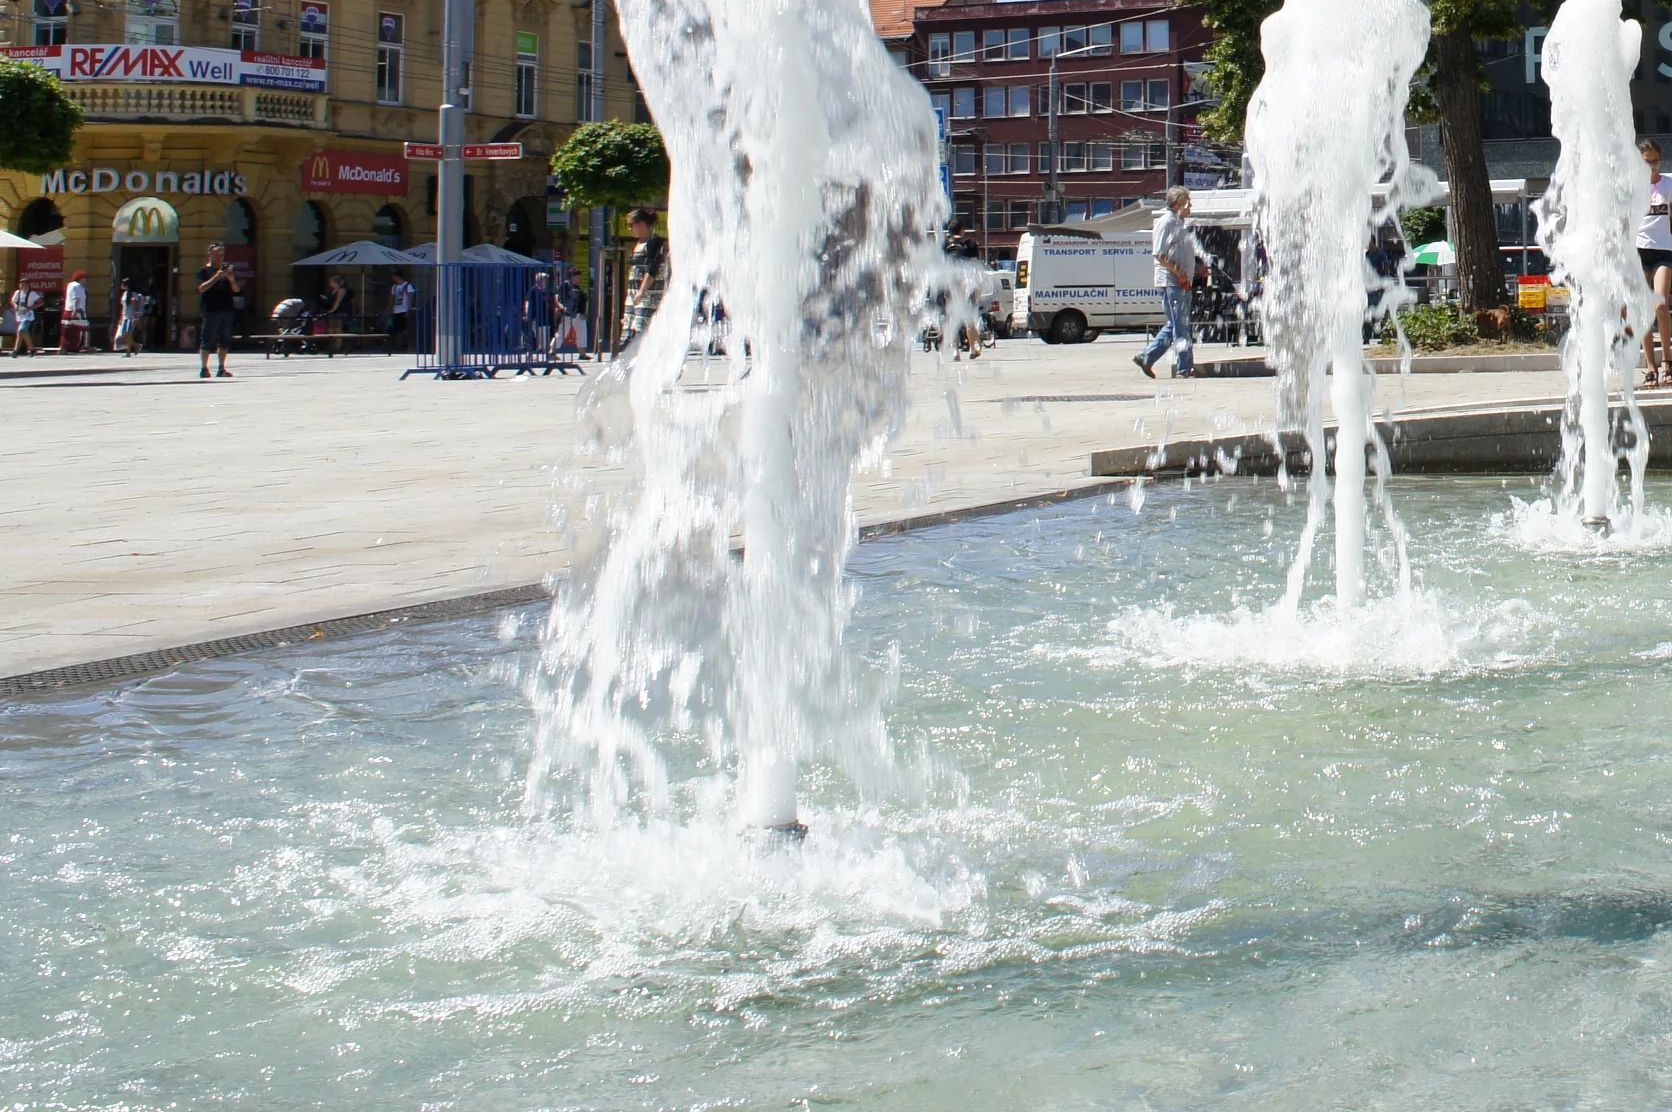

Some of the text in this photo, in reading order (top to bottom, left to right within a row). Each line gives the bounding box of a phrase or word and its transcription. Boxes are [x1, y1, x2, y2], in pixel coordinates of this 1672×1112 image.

[70, 46, 233, 80] RE/MAX Well
[40, 167, 249, 195] McDonald's
[1043, 248, 1096, 256] TRANSPORT
[1102, 248, 1134, 256] SERVIS
[1035, 288, 1108, 298] MANIPULAČNÍ
